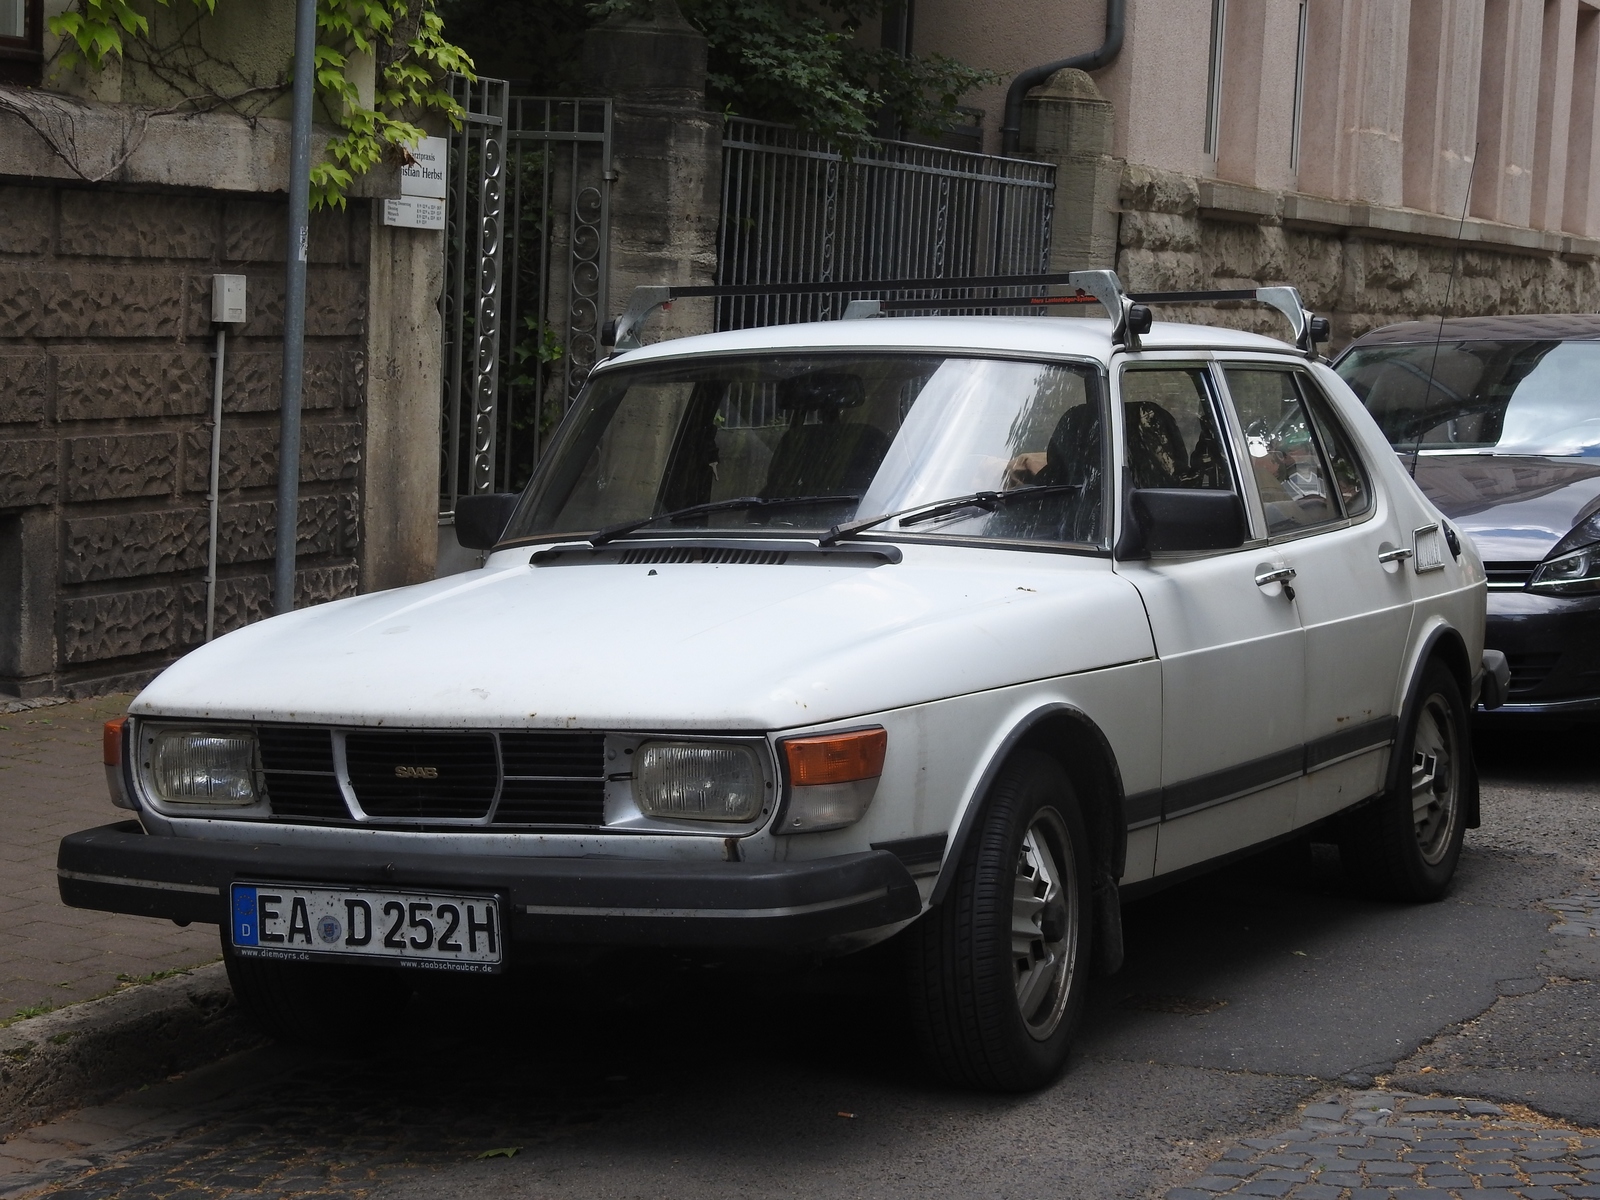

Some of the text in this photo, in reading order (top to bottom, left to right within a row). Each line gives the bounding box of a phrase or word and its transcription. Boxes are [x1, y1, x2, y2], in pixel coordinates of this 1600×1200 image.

[422, 167, 443, 180] Herbst
[395, 766, 438, 779] SAAB
[242, 923, 251, 937] D
[258, 894, 497, 953] EA D 252H
[400, 960, 493, 973] www.saabschrauber.de
